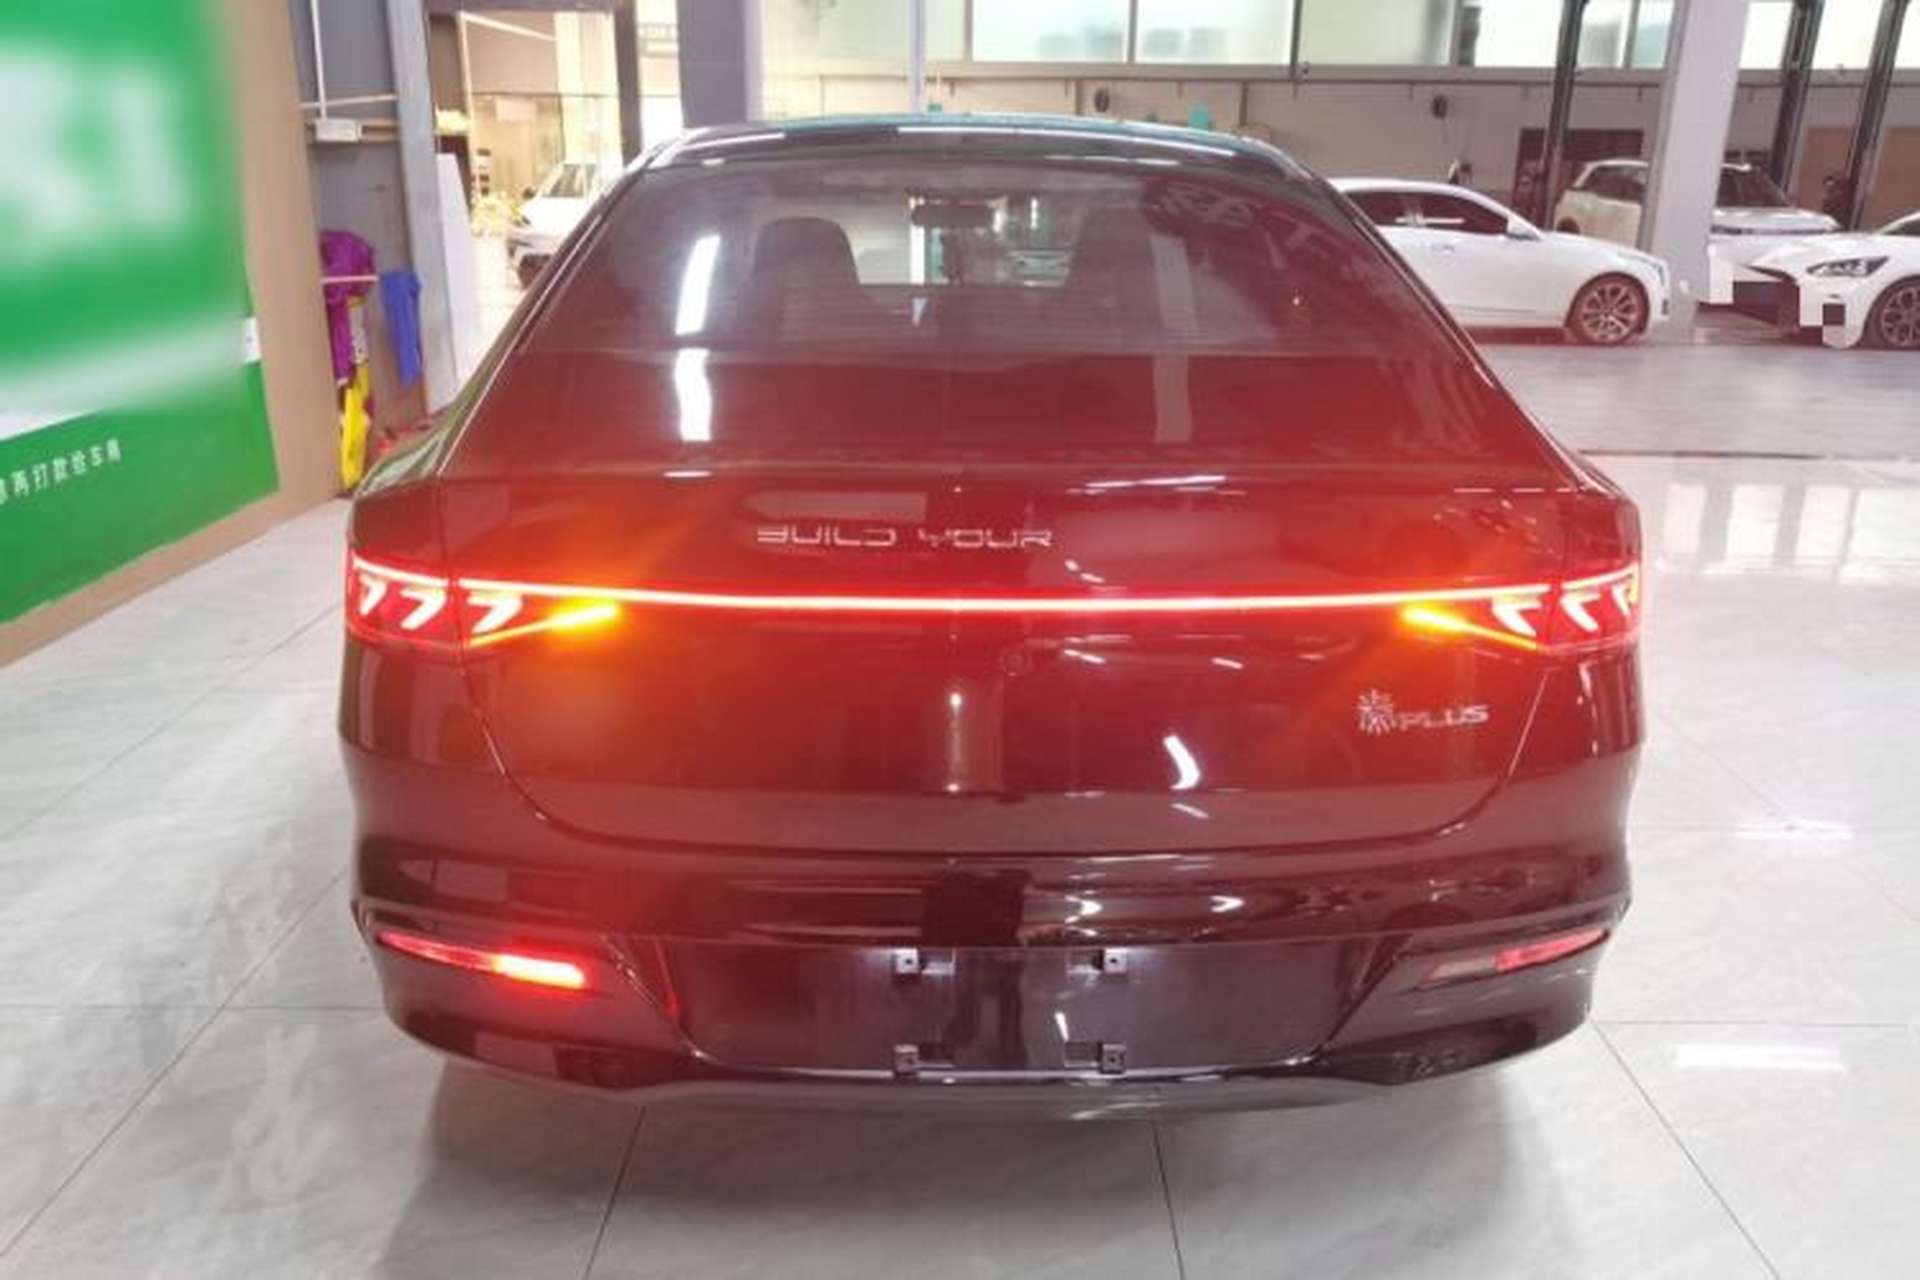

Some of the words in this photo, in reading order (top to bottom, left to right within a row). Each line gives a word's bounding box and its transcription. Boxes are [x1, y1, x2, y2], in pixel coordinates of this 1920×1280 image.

[756, 523, 897, 548] BUILD
[917, 525, 1054, 549] YOUR
[1397, 703, 1490, 732] PLUS
